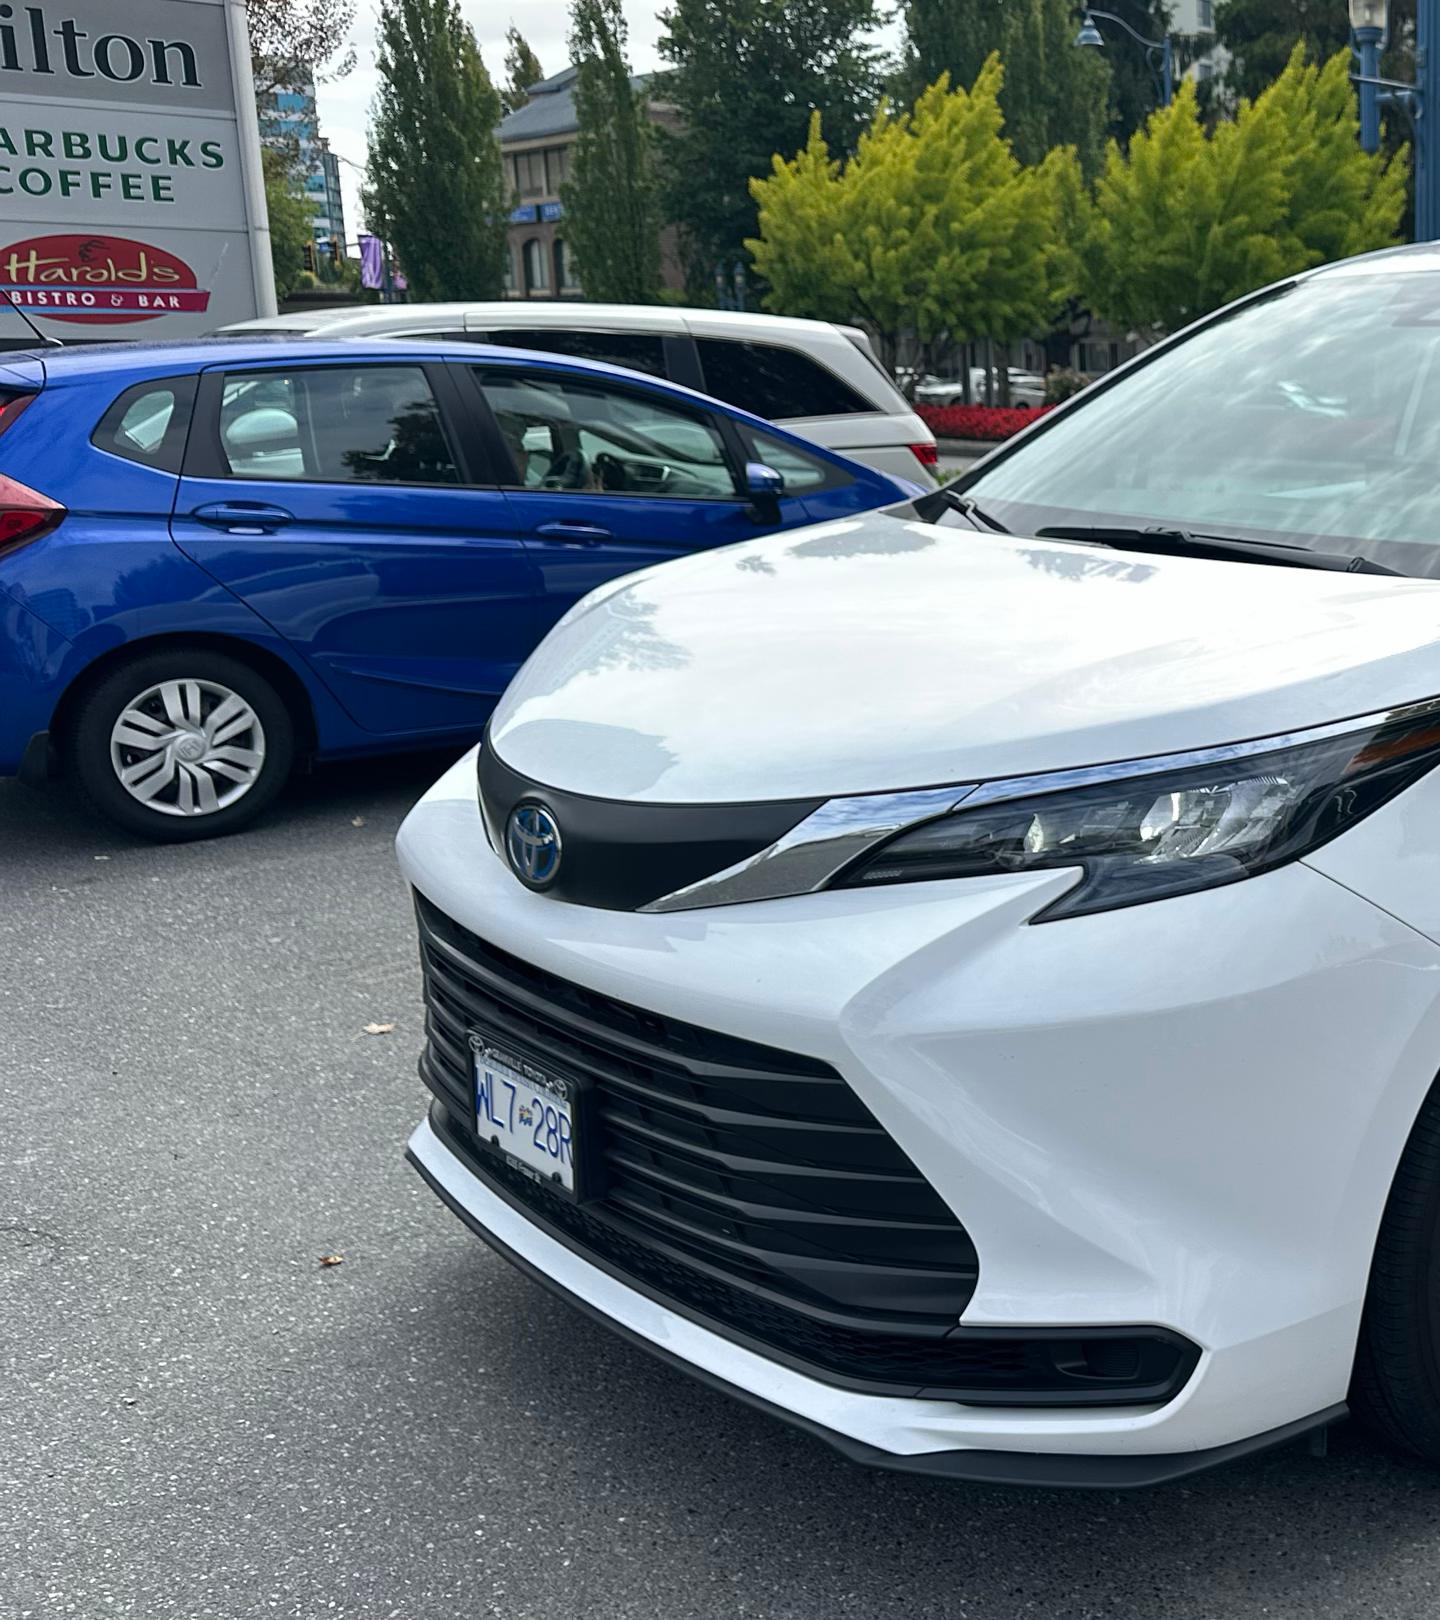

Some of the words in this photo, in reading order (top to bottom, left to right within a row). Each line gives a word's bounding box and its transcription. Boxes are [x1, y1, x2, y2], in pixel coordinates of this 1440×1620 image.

[0, 4, 202, 87] ilton
[0, 127, 224, 169] ARBUCKS
[4, 250, 181, 283] Harold's
[11, 291, 96, 306] BISTRO
[110, 294, 124, 306] &
[138, 294, 181, 308] BAR
[476, 1066, 517, 1134] WL7
[531, 1097, 573, 1168] 28R
